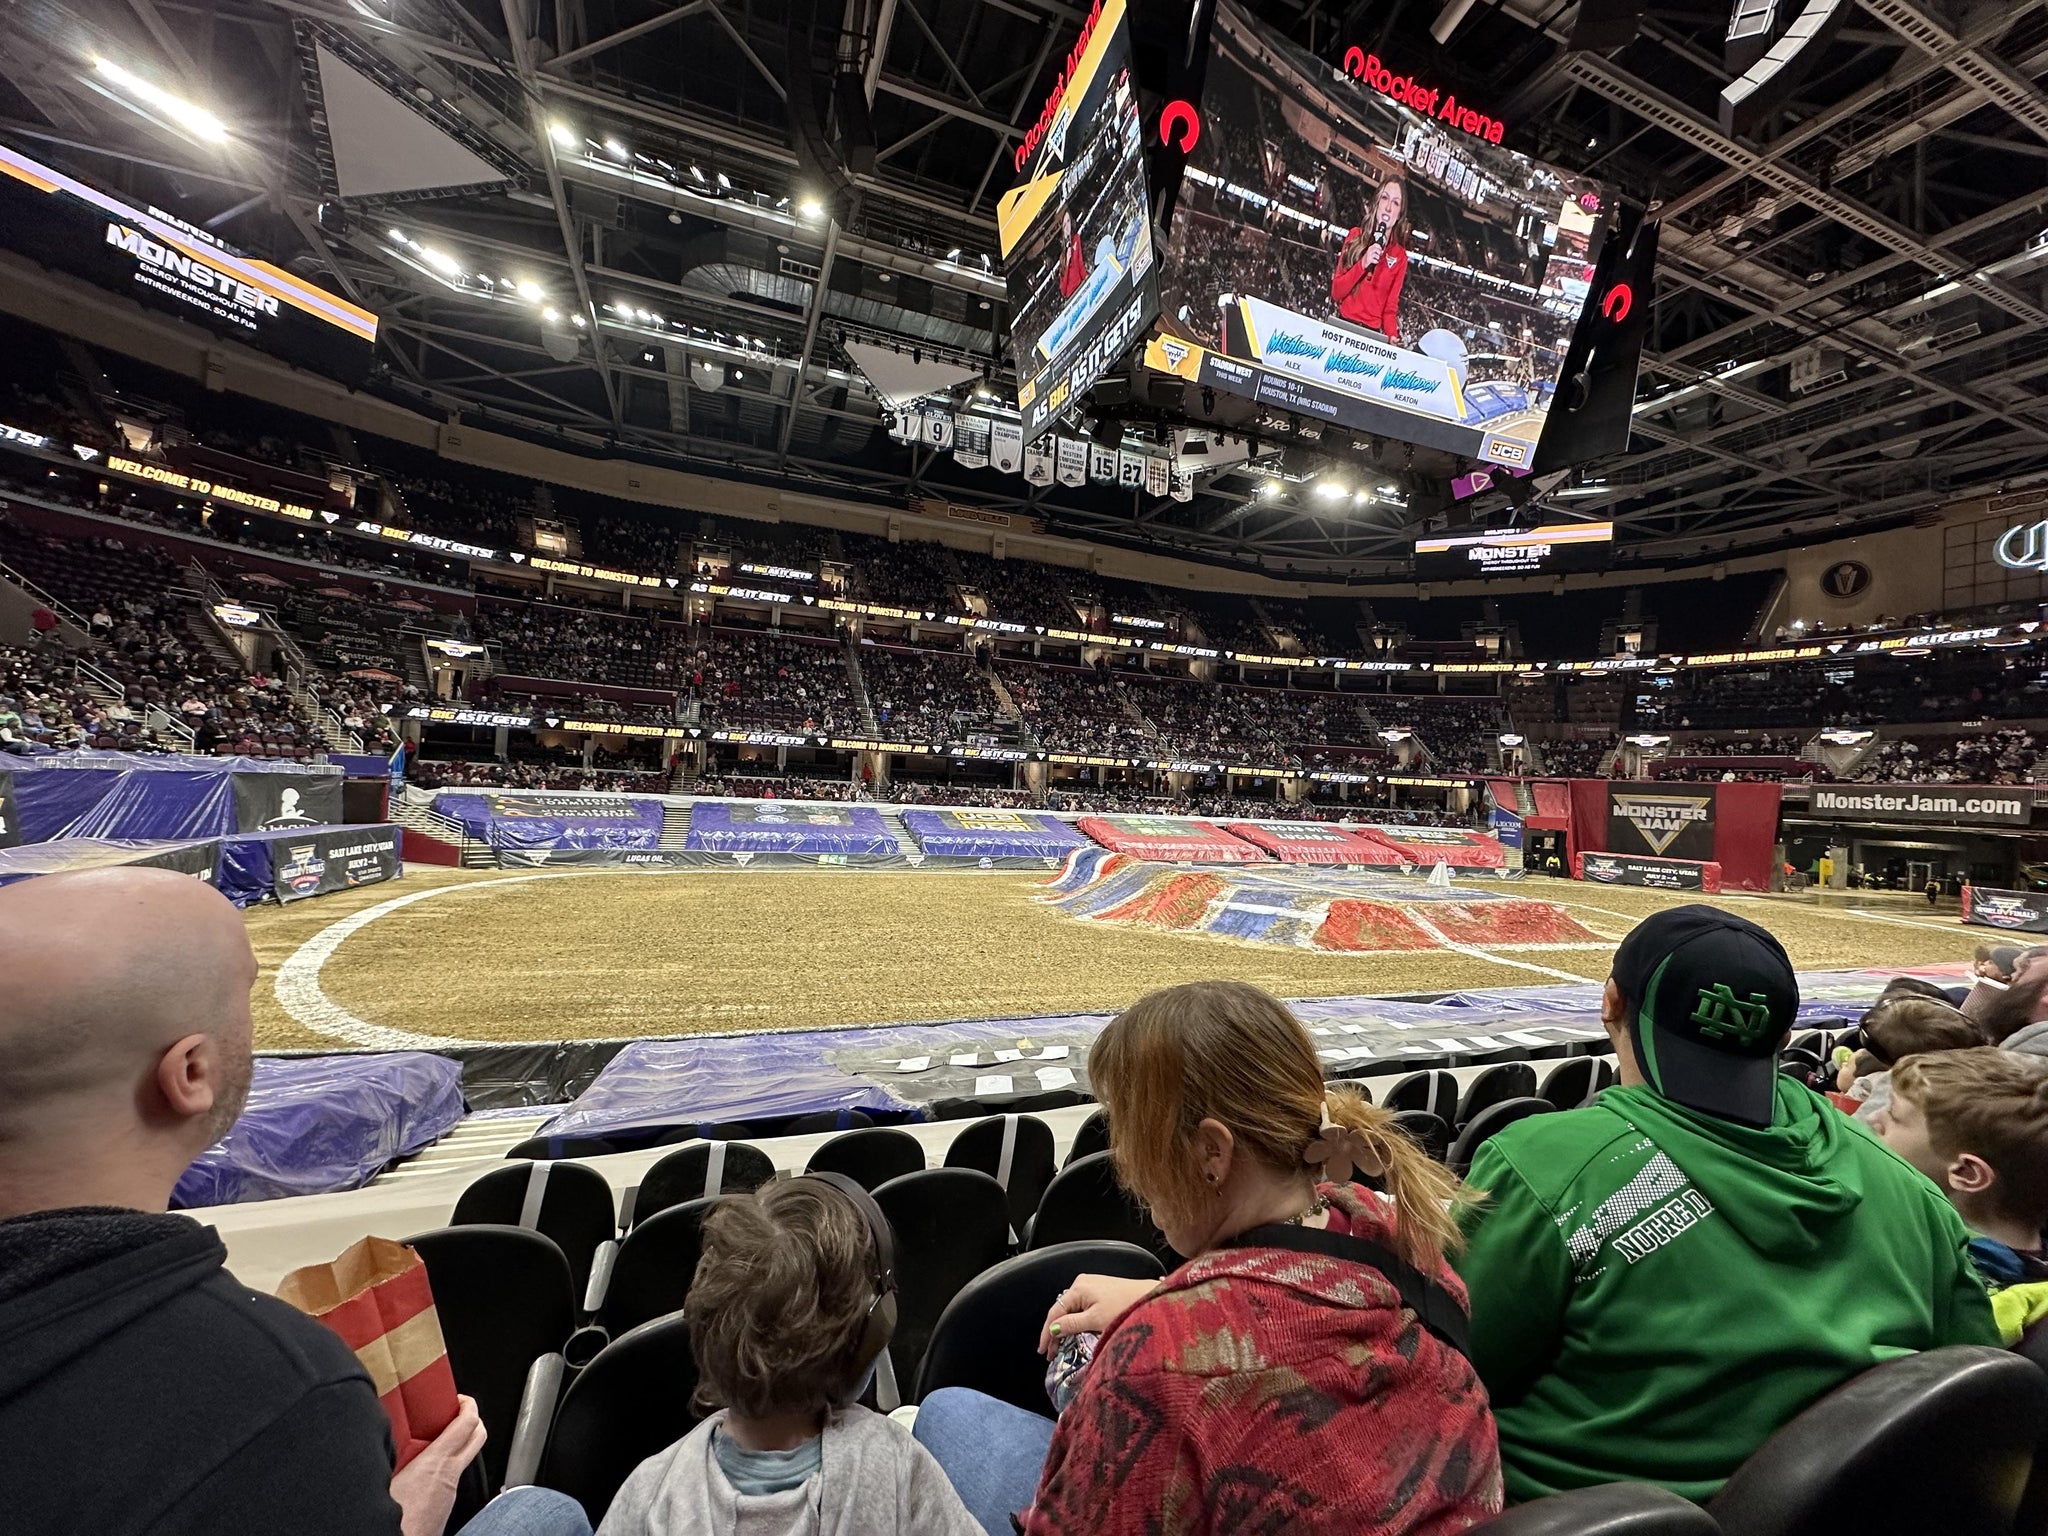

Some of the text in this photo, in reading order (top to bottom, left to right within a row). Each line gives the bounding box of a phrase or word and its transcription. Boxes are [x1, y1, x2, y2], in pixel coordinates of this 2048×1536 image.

[1024, 0, 1100, 158] Rocket Arena
[1363, 54, 1504, 144] Rocket Arena
[106, 223, 279, 317] MONSTER
[140, 263, 256, 318] ENERGY THROUGHOUT THE
[214, 307, 227, 317] SO
[228, 313, 240, 323] AS
[240, 318, 257, 330] FUN
[1266, 328, 1327, 360] MEGALODON
[1321, 329, 1398, 360] HOST PREDICTIONS
[1032, 399, 1047, 428] AS
[1050, 378, 1069, 412] BIG
[1071, 360, 1087, 390] AS
[1087, 343, 1102, 373] IT
[1104, 292, 1143, 356] GETS!
[1210, 357, 1253, 378] STADIUM WEST
[1285, 360, 1301, 370] ALEX
[1324, 347, 1385, 378] MEGALODON
[1216, 371, 1243, 384] THIS WEEK
[1263, 375, 1304, 393] ROUNDS 10-11
[1337, 377, 1362, 389] CARLOS
[1381, 367, 1441, 393] MEGALODON
[1260, 386, 1288, 402] HOUSTON,
[1289, 395, 1298, 404] TX
[1395, 393, 1418, 405] KEATON
[903, 416, 908, 435] 1
[933, 423, 942, 441] 9
[995, 431, 1020, 440] CHAMPIONS
[1490, 443, 1523, 460] JCB
[1096, 457, 1113, 476] 15
[1123, 464, 1141, 482] 27
[108, 455, 313, 520] WELCOME TO MONSTER JAM
[356, 521, 495, 559] AS BIG AS IT GETS!
[1468, 544, 1551, 560] MONSTER
[530, 557, 661, 587] WELCOME TO MONSTER JAM
[690, 582, 791, 604] AS BIG AS GETS!
[818, 599, 921, 620] WELCOME TO MONSTER JAM
[318, 616, 358, 629] Cleaning
[944, 615, 989, 628] AS BIG AS
[1047, 629, 1132, 647] WELCOME TO MONSTER JAM
[1856, 627, 2001, 651] AS BIG AS IT GETS!
[1557, 658, 1658, 670] AS BIG AS GETS!
[1687, 647, 1822, 665] WELCOME TO MONSTER JAM
[1514, 663, 1532, 672] JAM
[407, 707, 531, 727] AS BIG AS IT GETS!
[563, 720, 684, 739] WELCOME TO MONSTER JAM
[712, 730, 806, 746] AS BIG AS GETS!
[831, 739, 929, 754] WELCOME TO MONSTER JAM
[1048, 754, 1129, 767] WELCOME TO MONSTER JAM
[1613, 804, 1707, 821] MONSTER
[1817, 793, 2021, 815] MonsterJam.com
[1638, 817, 1681, 831] JAM
[329, 849, 345, 859] SALT
[346, 847, 362, 856] LAKE
[378, 841, 394, 851] UTAH
[626, 855, 664, 863] LUCAS OIL
[348, 858, 361, 869] JULY
[373, 856, 377, 864] 4
[1661, 867, 1678, 875] CITY,
[2009, 910, 2036, 918] FINALS
[1612, 1198, 1691, 1265] NOTRE
